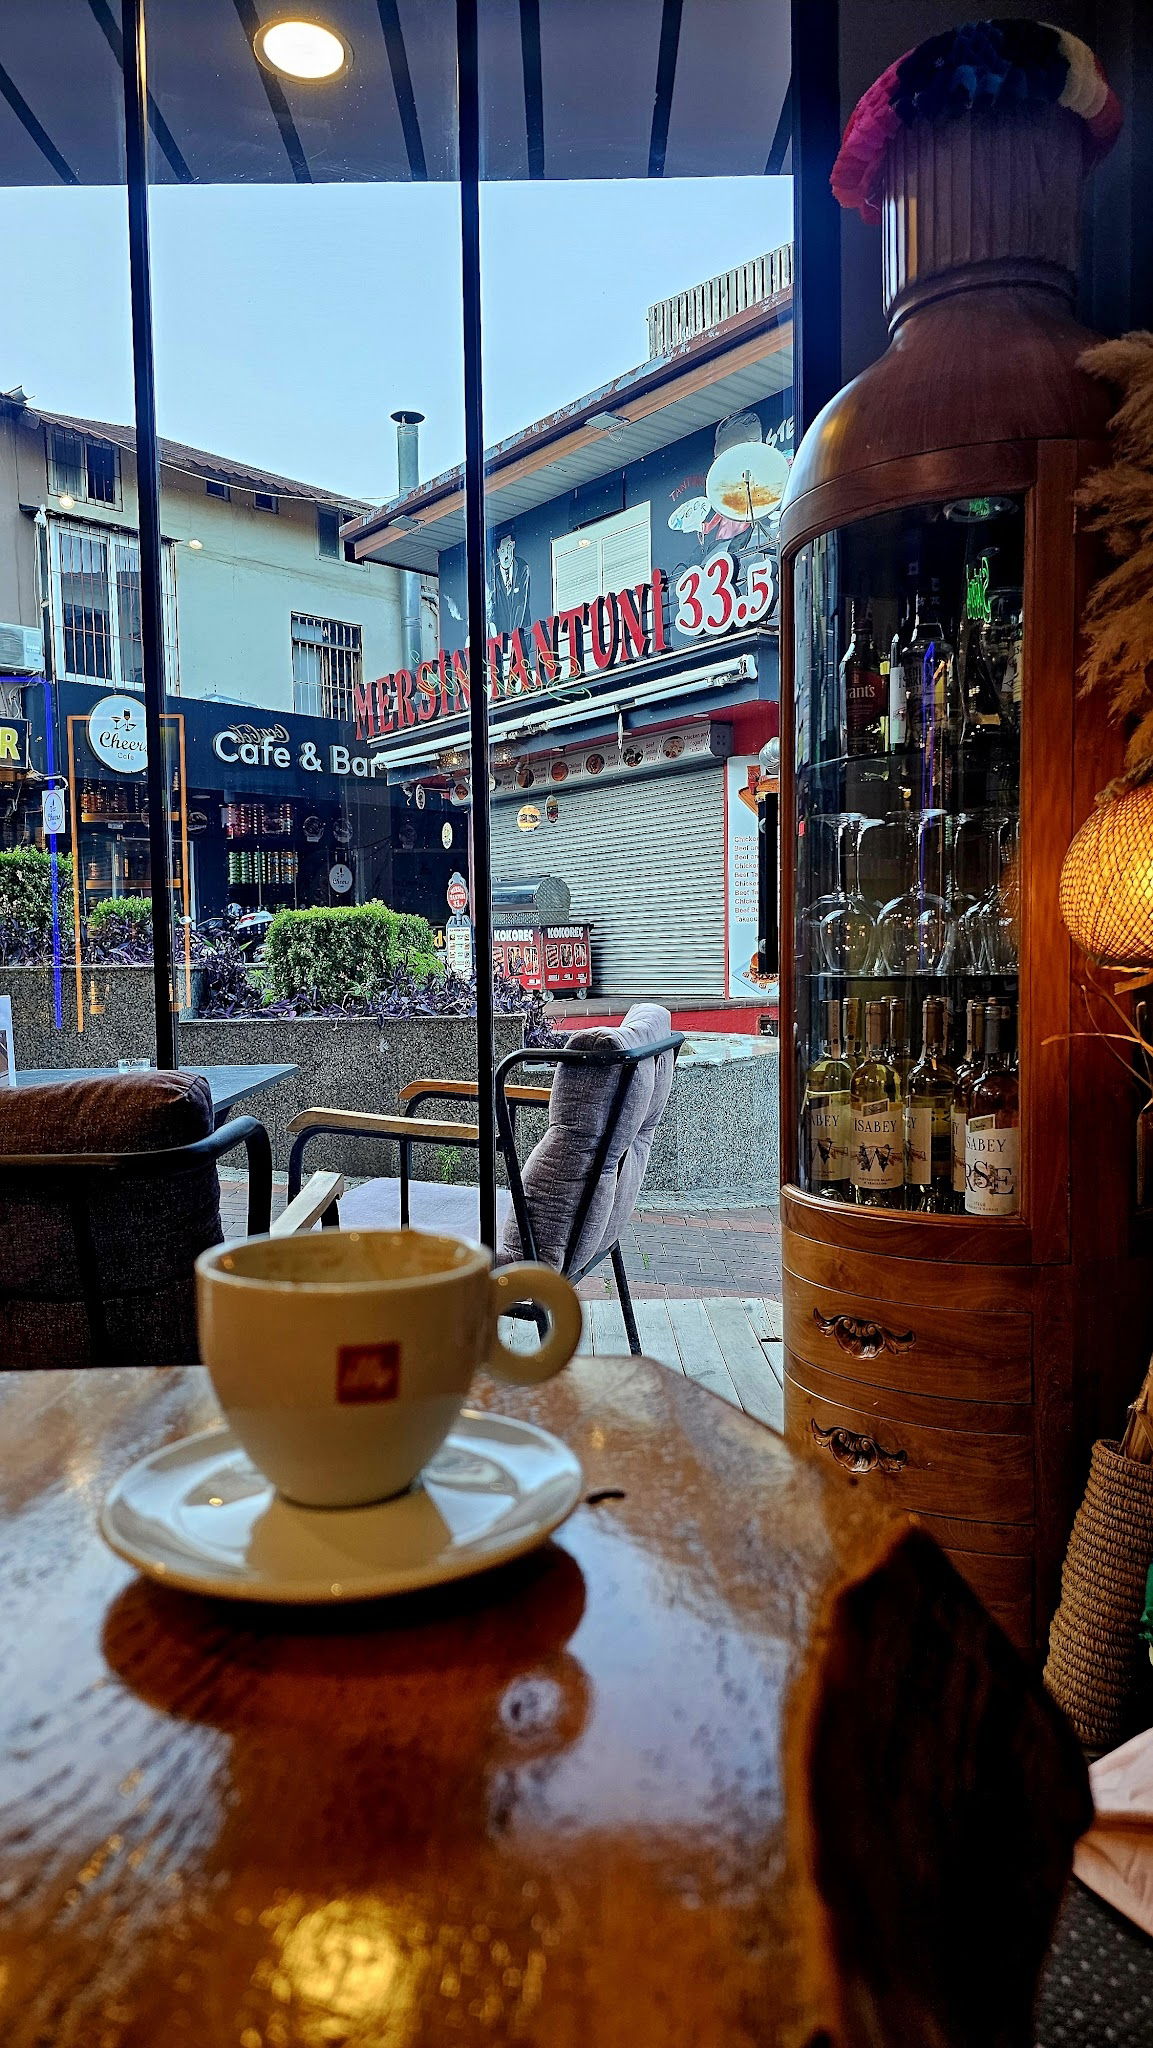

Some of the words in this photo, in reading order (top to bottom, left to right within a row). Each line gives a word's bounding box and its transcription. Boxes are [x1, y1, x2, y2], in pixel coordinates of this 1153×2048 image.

[677, 556, 771, 631] 33.5
[100, 731, 148, 752] Cheer
[213, 731, 291, 768] Cafe
[300, 741, 323, 772] &
[330, 745, 377, 778] Bar
[493, 929, 534, 944] KOKOREÇ
[548, 926, 584, 940] KOKOREÇ
